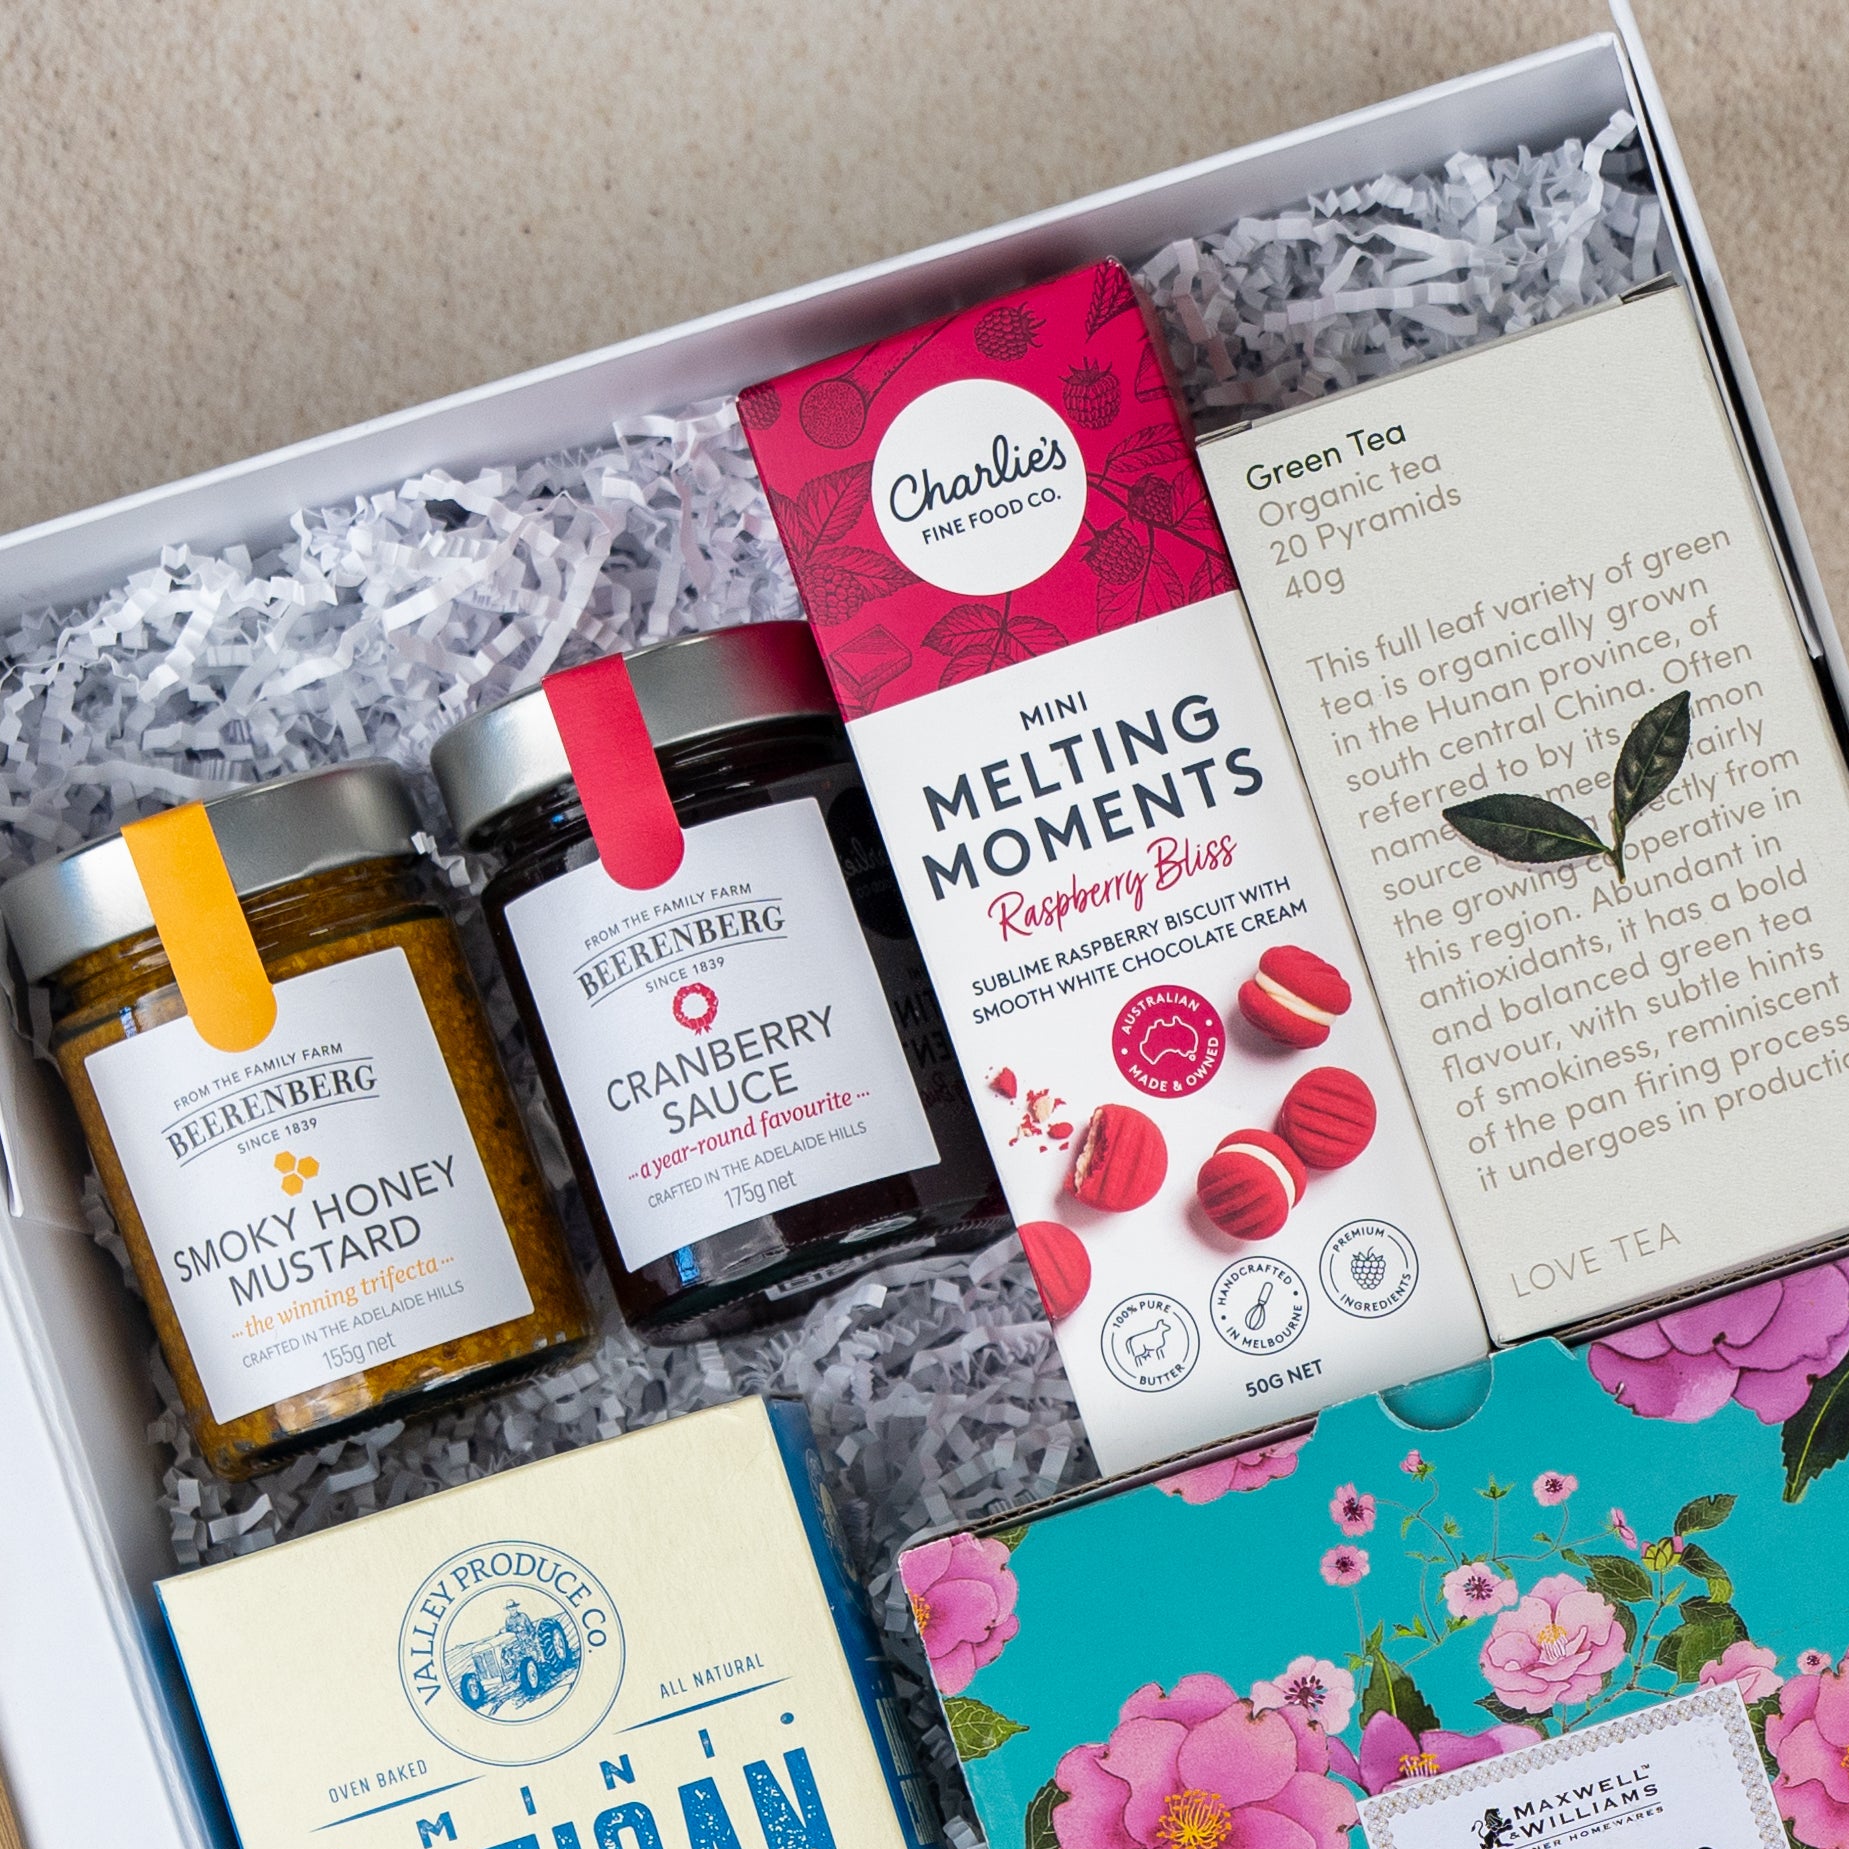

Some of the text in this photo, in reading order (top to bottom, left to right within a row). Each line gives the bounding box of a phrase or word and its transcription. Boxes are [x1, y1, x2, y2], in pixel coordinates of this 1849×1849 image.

[889, 435, 1067, 523] Charlie's
[1246, 424, 1407, 491] Green Tea
[1258, 453, 1442, 527] Organic tea
[922, 487, 1062, 545] FINE FOOD CO.
[1269, 483, 1462, 566] 20 Pyramids
[1285, 567, 1345, 599] 40g
[1019, 690, 1088, 731] MINI
[922, 694, 1220, 832] MELTING
[922, 747, 1263, 901] MOMENTS
[584, 882, 752, 950] FROM THE FAMILY FARM
[987, 834, 1237, 942] Raspberry Bliss
[577, 906, 785, 999] BEERENBERG
[972, 875, 1291, 996] SUBLIME RASPBERRY BISCUIT WITH
[972, 898, 1308, 1025] SMOOTH WHITE CHOCOLATE CREAM
[645, 956, 725, 993] SINCE 1839
[1121, 992, 1199, 1035] AUSTRALIAN
[1442, 941, 1824, 1083] flavour, with subtle hints
[1456, 970, 1840, 1118] of smokiness, reminiscent
[173, 1042, 343, 1109] FROM THE FAMILY FARM
[607, 1005, 832, 1112] CRANBERRY
[1125, 1064, 1170, 1094] MADE
[1186, 1033, 1222, 1086] OWNED
[167, 1065, 377, 1158] BEERENBERG
[662, 1061, 799, 1135] SAUCE
[237, 1117, 317, 1154] SINCE 1839
[647, 1120, 868, 1209] CRAFTED IN THE ADELAIDE HILLS
[651, 1115, 757, 1180] year-round
[1477, 1165, 1498, 1192] it
[1508, 1114, 1672, 1181] undergoes
[1676, 1100, 1707, 1125] in
[173, 1154, 455, 1283] SMOKY HONEY
[724, 1170, 798, 1208] 175g net
[228, 1215, 421, 1306] MUSTARD
[1332, 1227, 1385, 1252] PREMIUM
[1510, 1222, 1681, 1298] LOVE TEA
[277, 1280, 359, 1325] winning
[1112, 1300, 1171, 1328] 100% PURE
[1217, 1263, 1292, 1306] HANDCRAFTED
[1340, 1273, 1412, 1312] INGREDIENTS
[242, 1279, 465, 1369] CRAFTED IN THE ADELAIDE HILLS
[323, 1331, 397, 1369] 155g net
[1226, 1305, 1303, 1349] IN MELBOURNE
[1139, 1363, 1184, 1386] BUTTER
[1245, 1358, 1322, 1398] 50G NET
[410, 1580, 456, 1706] VALLEY
[450, 1552, 592, 1608] PRODUCE
[659, 1653, 764, 1699] ALL NATURAL
[328, 1759, 428, 1803] OVEN BAKED
[415, 1728, 715, 1849] MINI
[1569, 1806, 1664, 1841] HOMEWARES
